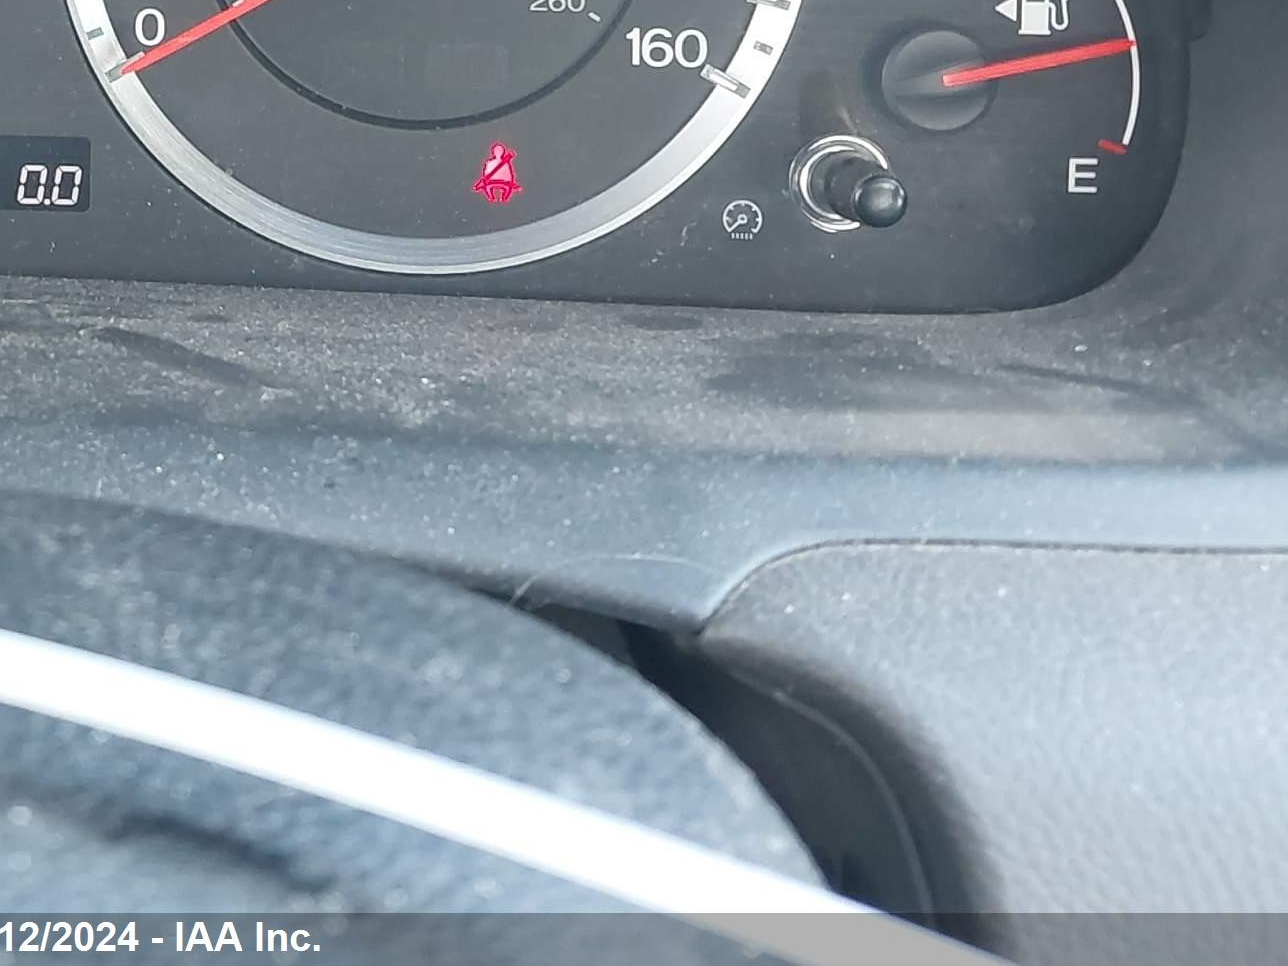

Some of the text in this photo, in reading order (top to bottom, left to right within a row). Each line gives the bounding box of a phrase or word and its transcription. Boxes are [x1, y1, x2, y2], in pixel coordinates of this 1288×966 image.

[135, 9, 165, 46] 0
[627, 30, 707, 68] 160
[17, 165, 81, 206] 0.0
[1068, 159, 1097, 193] E
